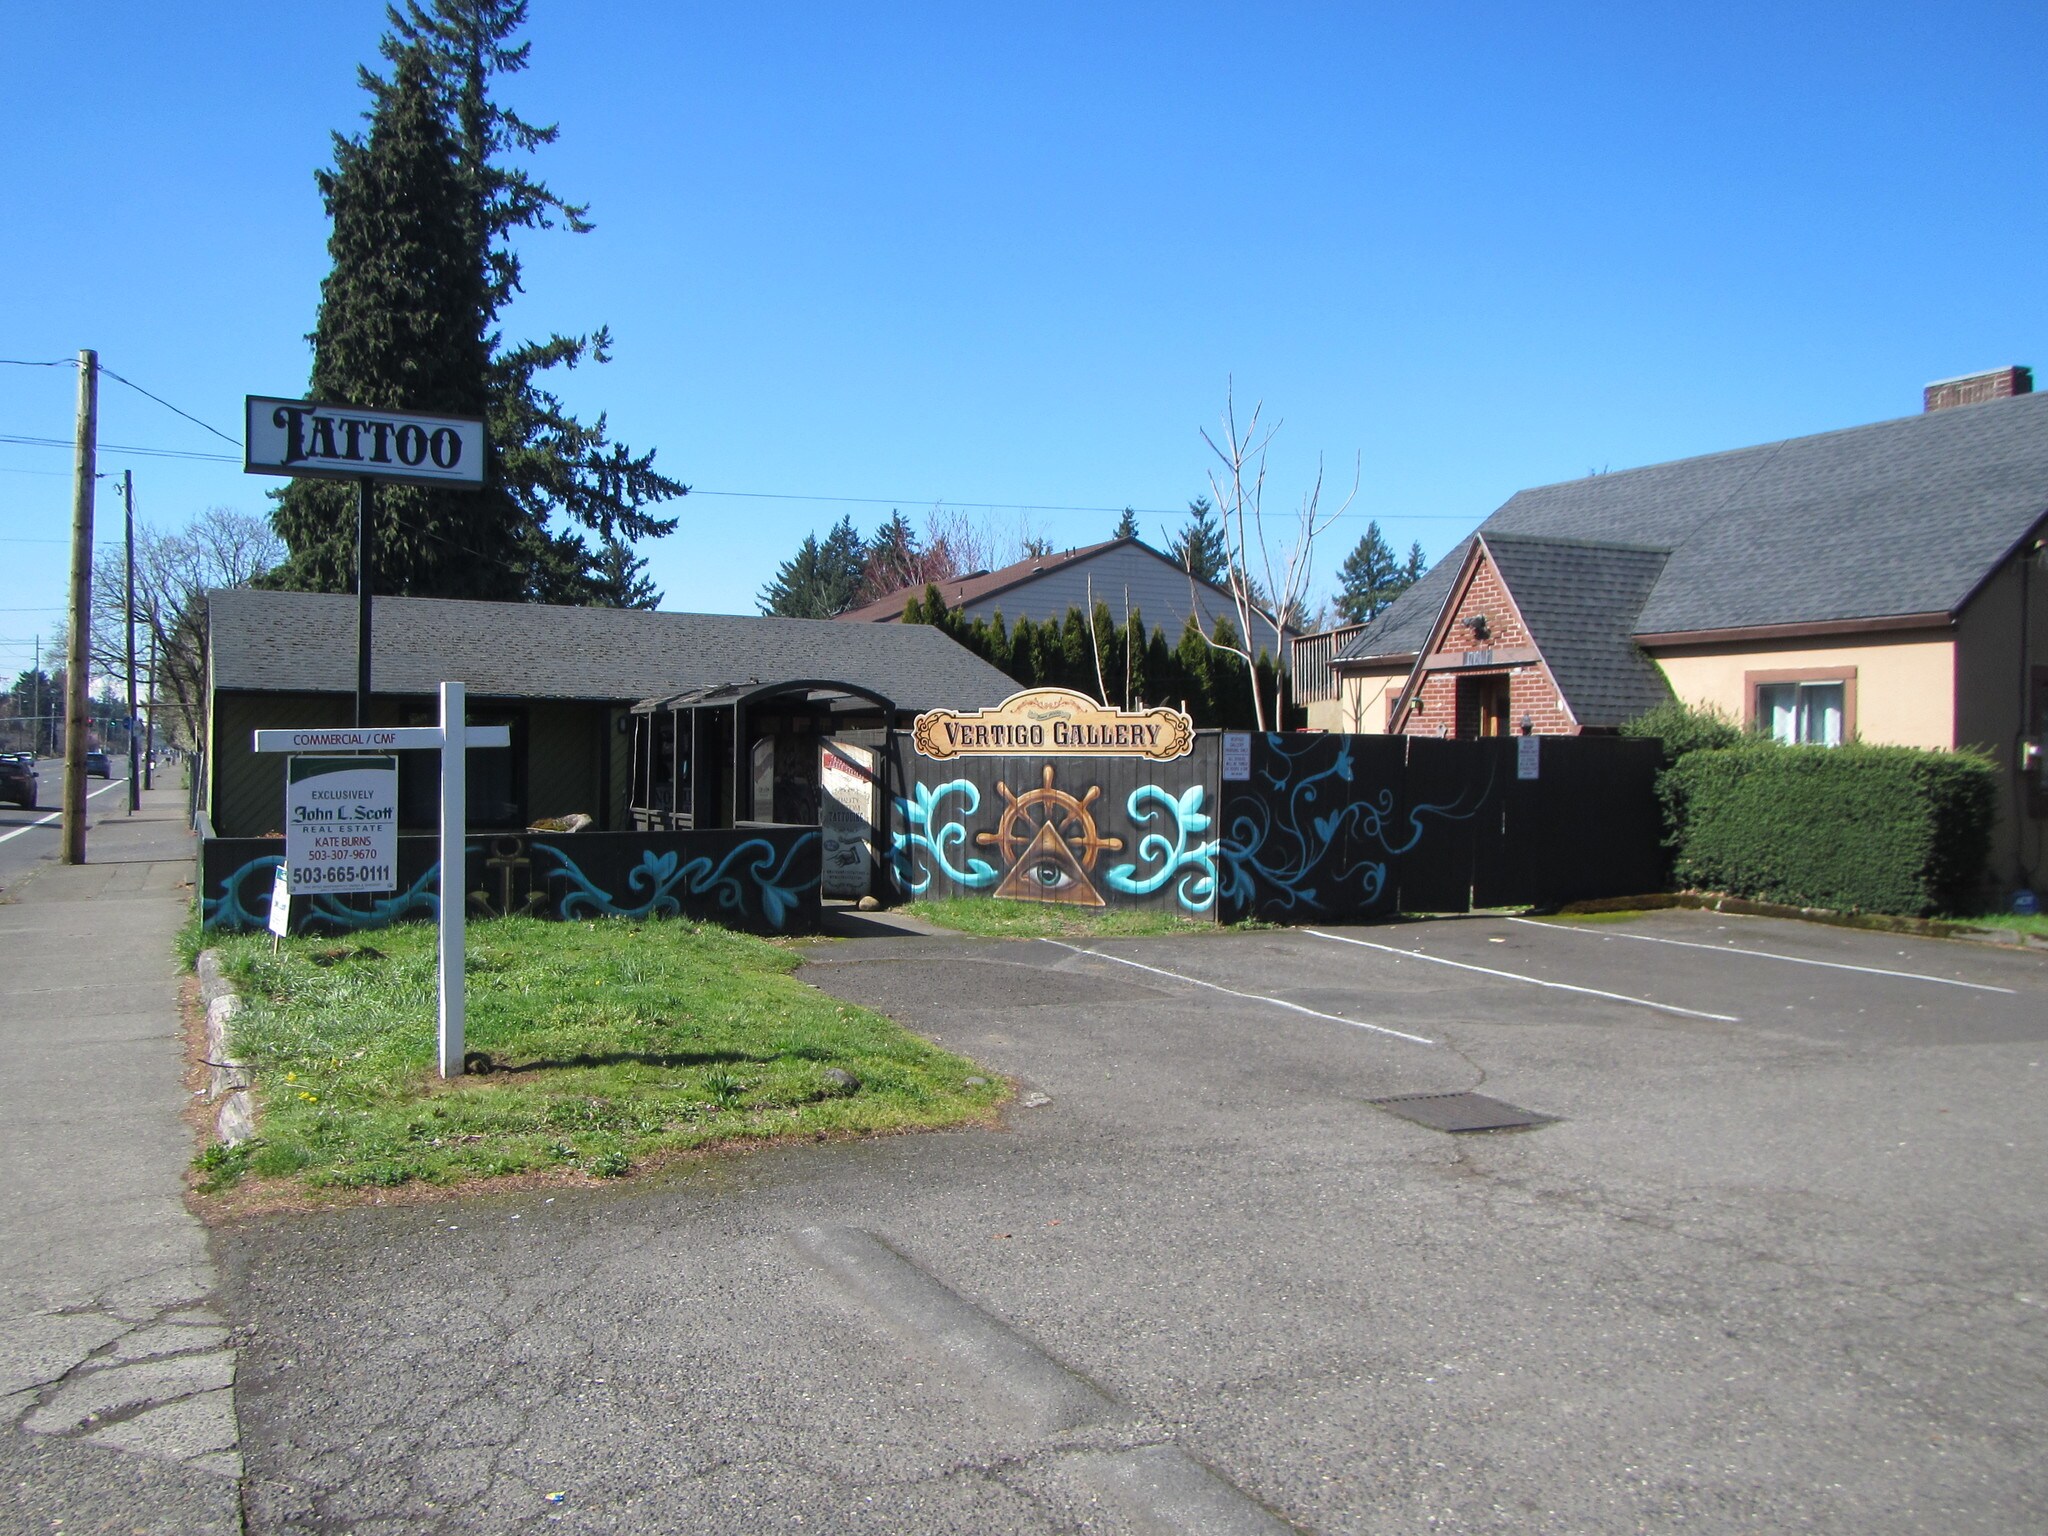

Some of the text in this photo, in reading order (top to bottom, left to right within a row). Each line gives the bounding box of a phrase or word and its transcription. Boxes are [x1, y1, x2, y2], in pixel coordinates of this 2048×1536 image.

[272, 406, 463, 469] TATTOO
[293, 733, 396, 745] COMMERCIAL / CMF
[944, 721, 1161, 747] VERTIGO GALLERY
[312, 790, 374, 800] EXCLUSIVELY
[291, 805, 393, 823] John L. Scott
[315, 836, 372, 847] KATE BURNS
[309, 849, 377, 860] 503-307-9670
